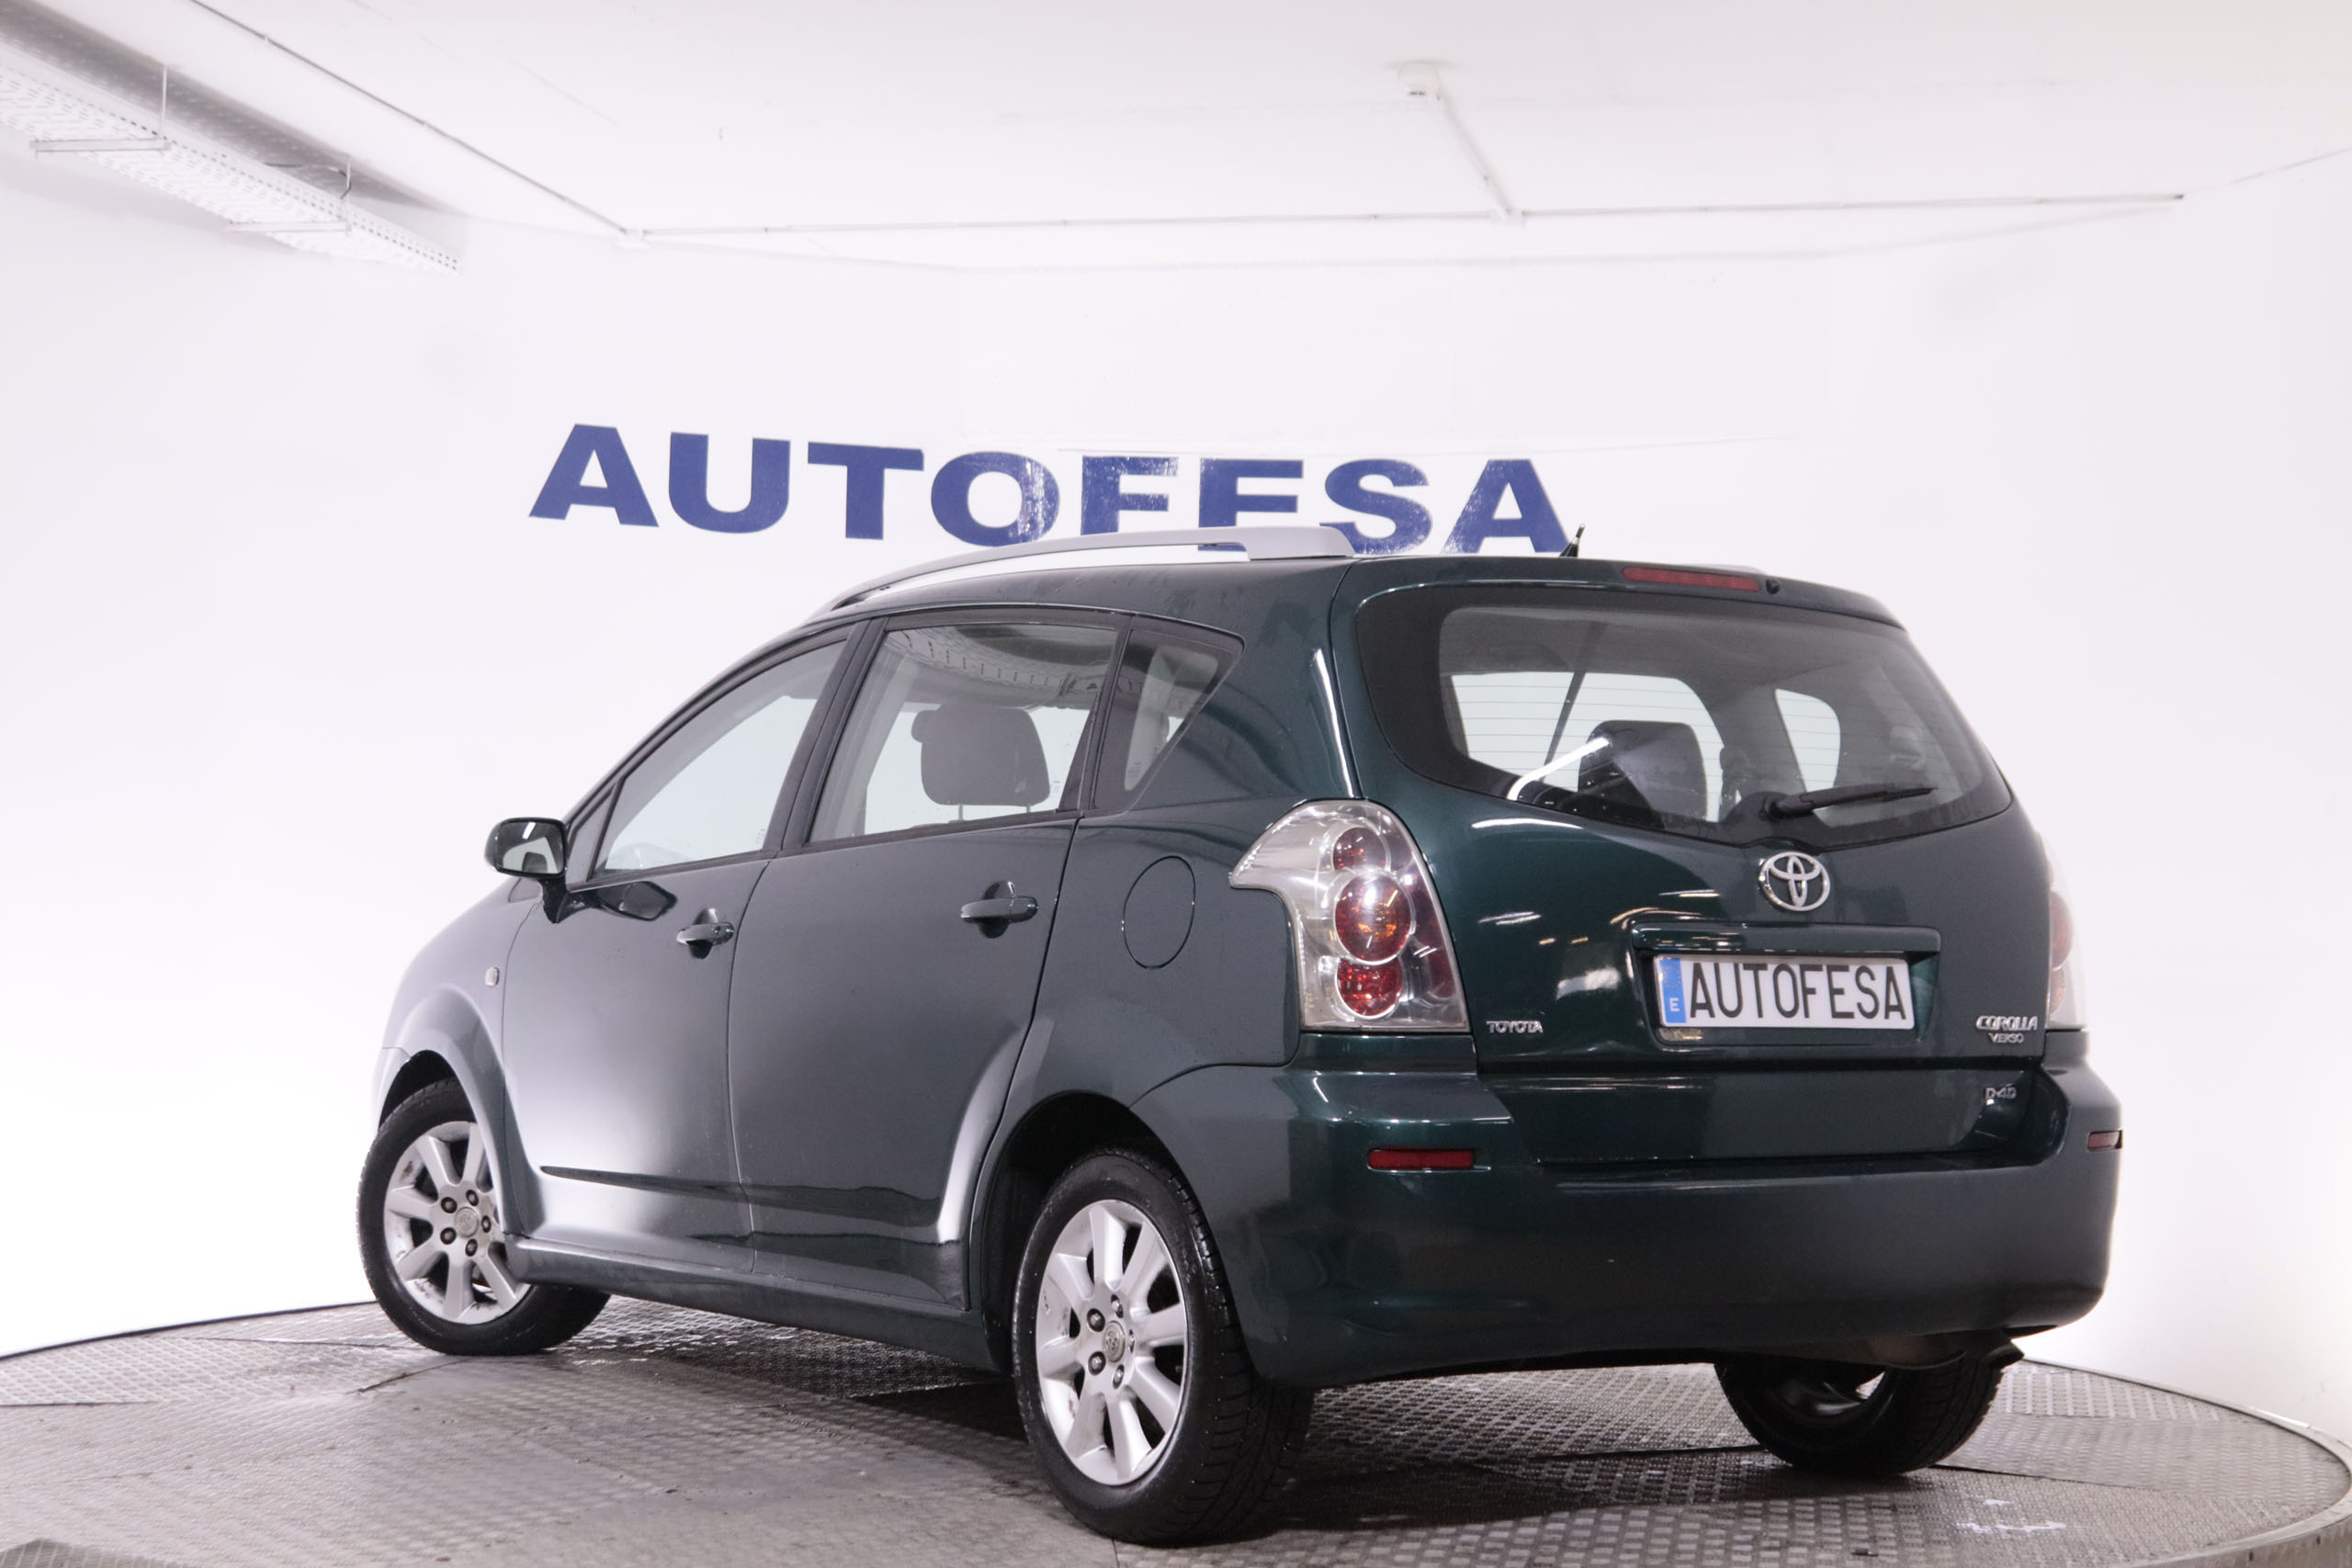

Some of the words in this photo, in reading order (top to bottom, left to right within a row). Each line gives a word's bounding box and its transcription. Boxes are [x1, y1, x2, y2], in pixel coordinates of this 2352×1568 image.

[528, 423, 1573, 555] AUTOFESA
[1690, 962, 1906, 1021] AUTOFESA
[1486, 1020, 1544, 1034] TOYOTA
[1975, 1015, 2039, 1031] COROLLA
[1988, 1032, 2025, 1043] VERSO
[1985, 1087, 2018, 1100] D-4D
